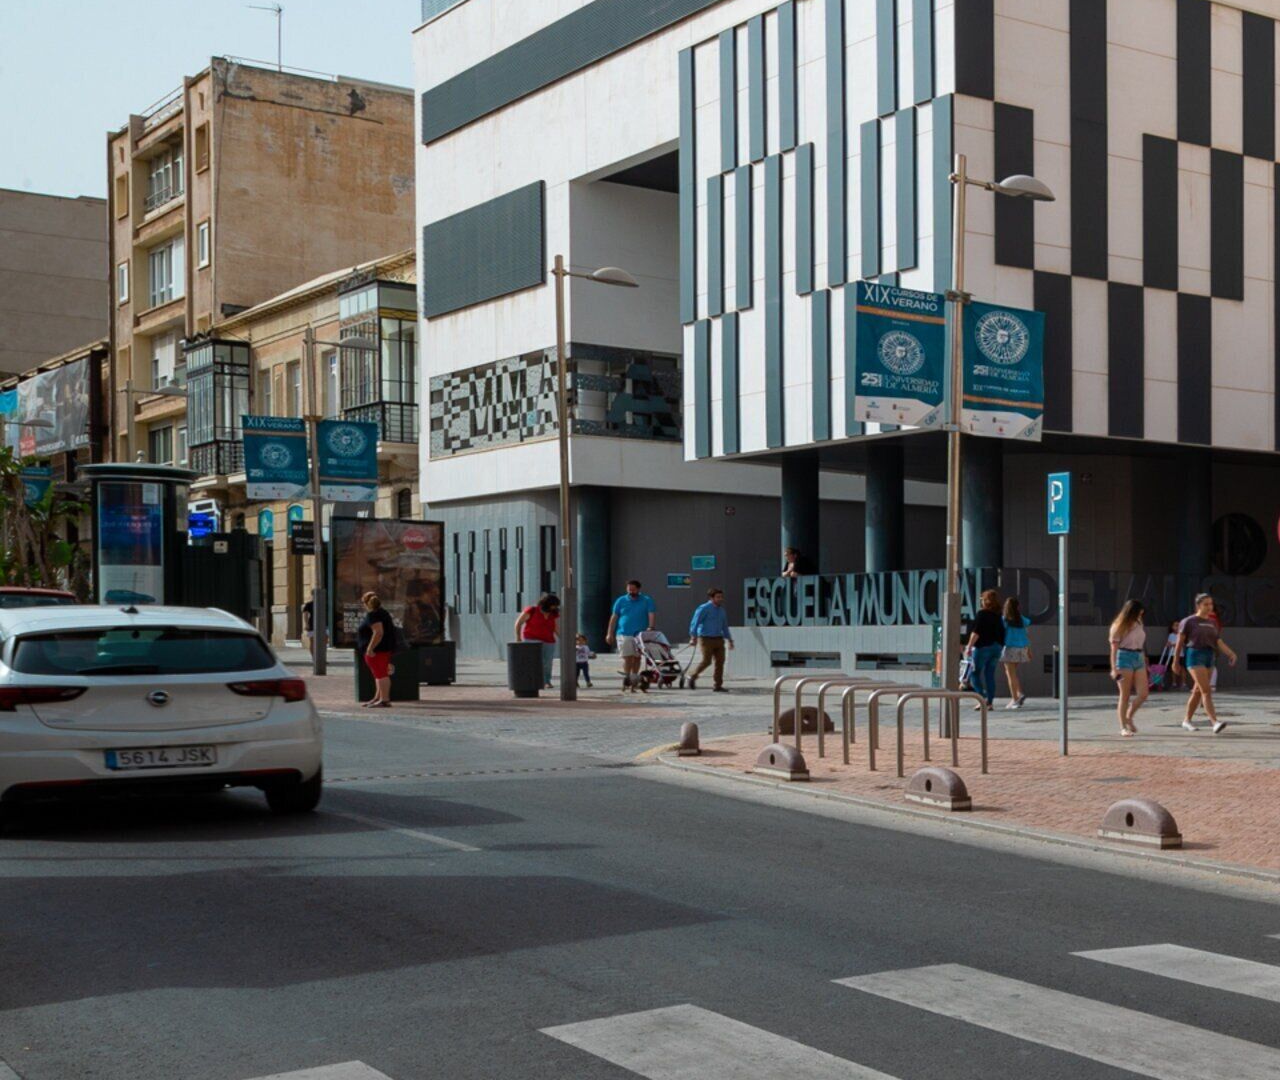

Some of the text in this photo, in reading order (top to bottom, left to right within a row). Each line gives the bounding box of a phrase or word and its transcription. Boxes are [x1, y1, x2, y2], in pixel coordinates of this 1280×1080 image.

[864, 283, 891, 305] XIX
[891, 288, 939, 302] CURSOS DE
[891, 297, 938, 312] VERANO
[884, 374, 940, 388] UNIVERSIDAD
[1050, 480, 1063, 513] P
[744, 575, 847, 627] ESCUELA
[858, 569, 984, 626] MUNICIAL
[120, 748, 211, 765] 5614 JSK
